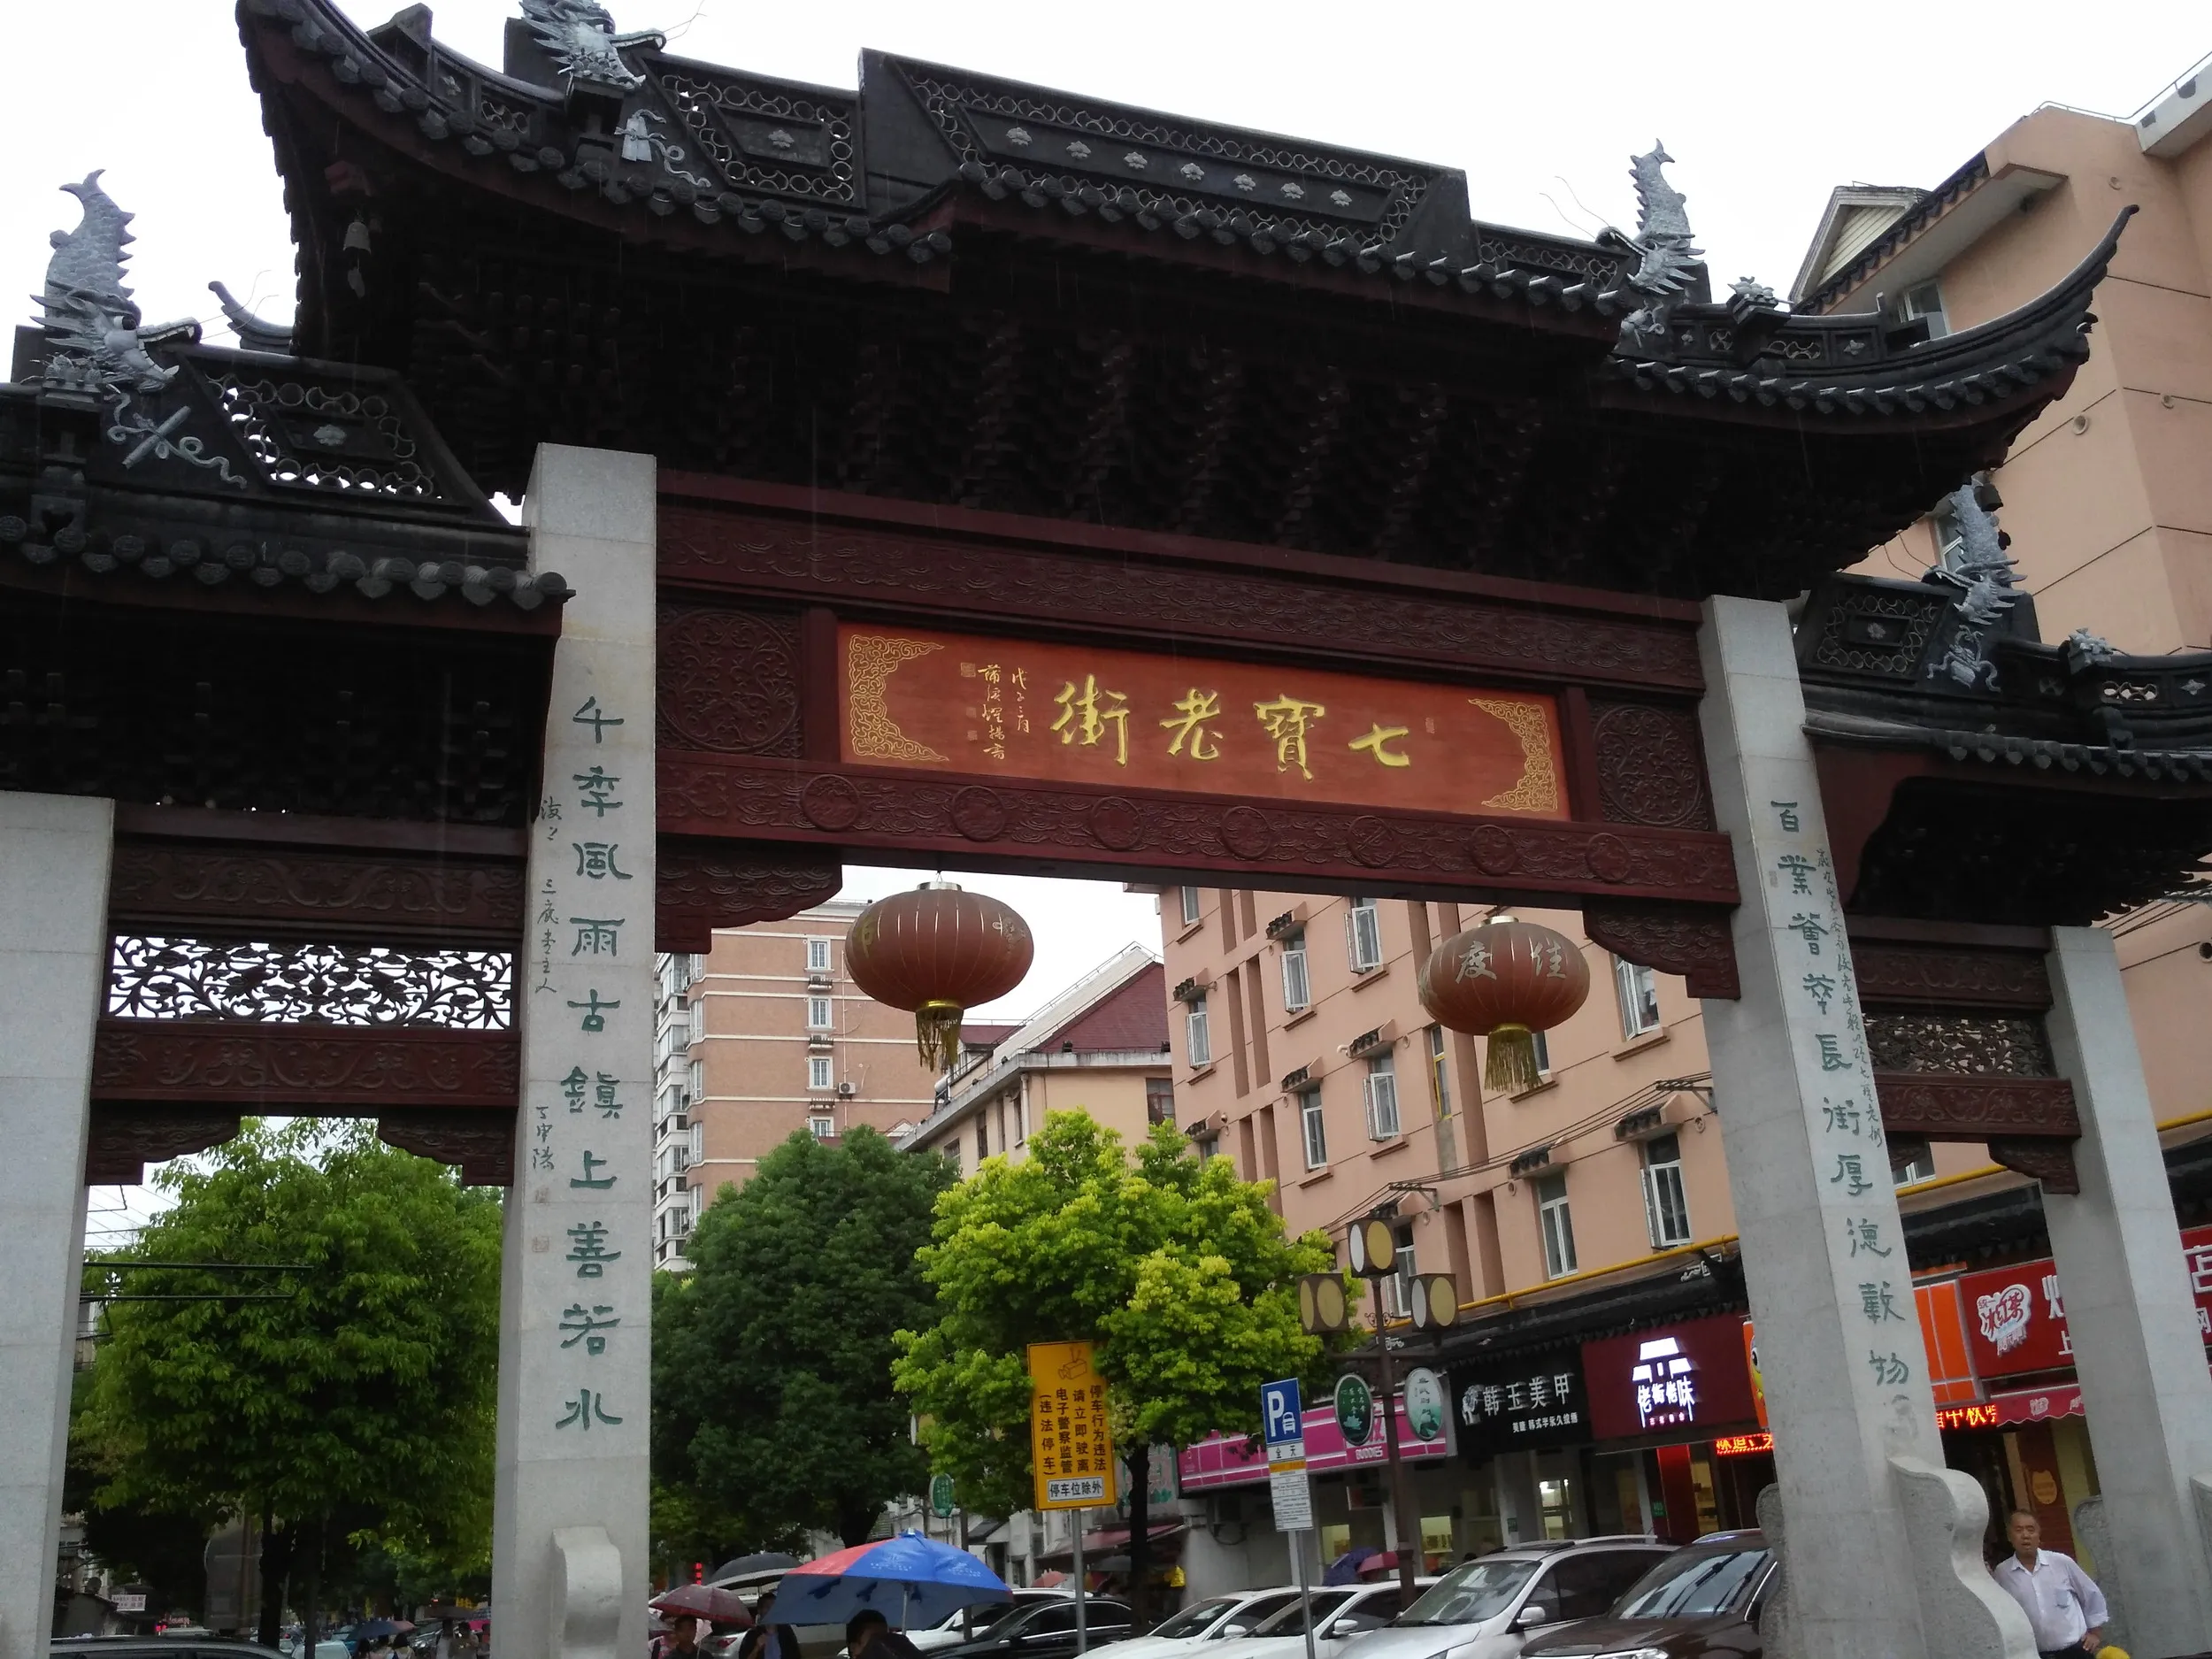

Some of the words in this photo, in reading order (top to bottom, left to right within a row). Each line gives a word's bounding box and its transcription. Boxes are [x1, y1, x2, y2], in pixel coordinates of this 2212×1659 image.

[1267, 1390, 1285, 1438] P
[1483, 1373, 1570, 1416] 韩玉美甲
[1056, 1387, 1072, 1473] 电子警察监管
[1072, 1389, 1089, 1472] 请立即驶离
[1089, 1385, 1106, 1471] 停车行为违法
[1050, 1481, 1102, 1497] 停车位除外
